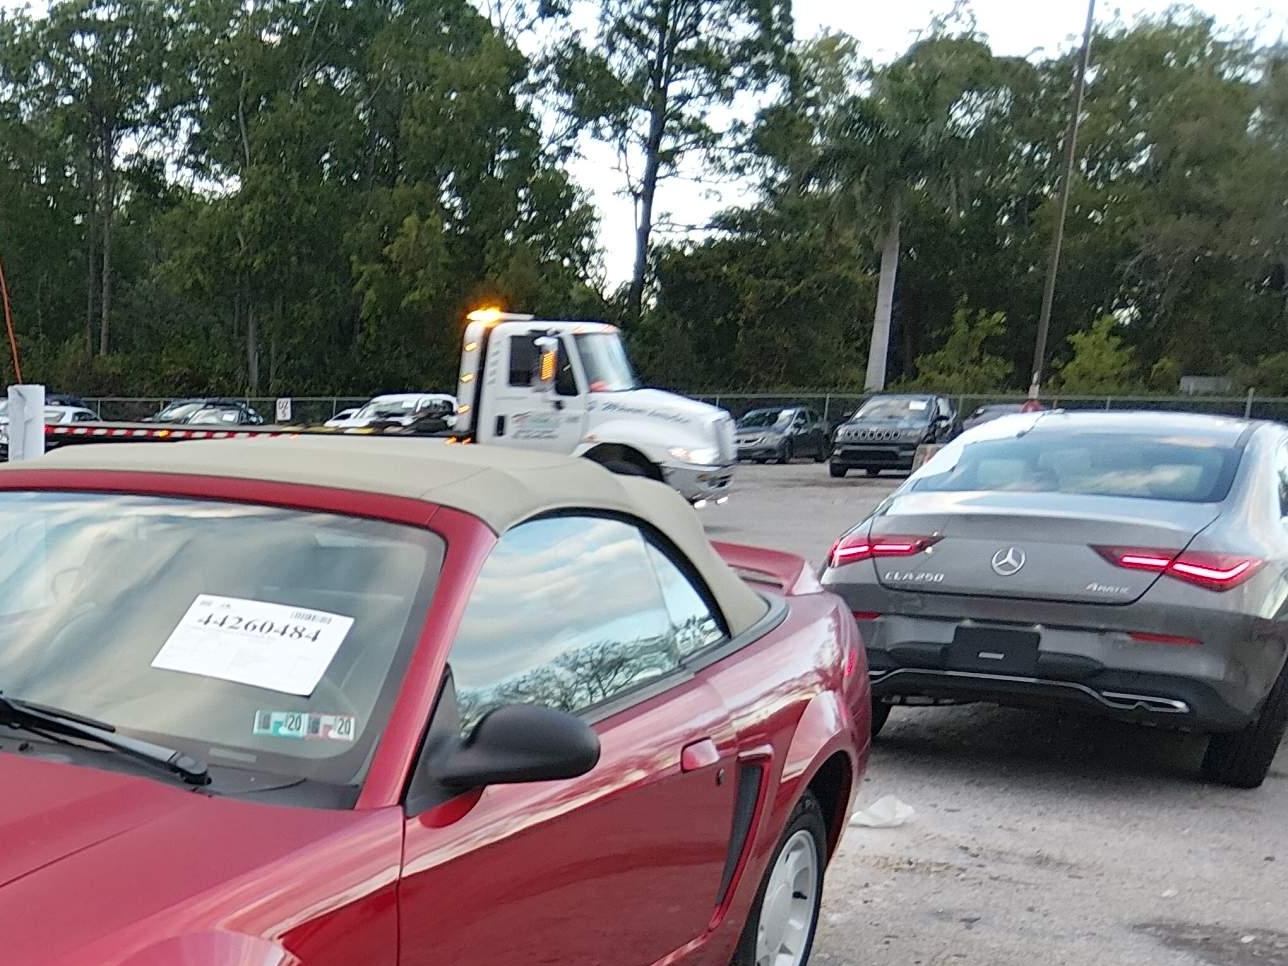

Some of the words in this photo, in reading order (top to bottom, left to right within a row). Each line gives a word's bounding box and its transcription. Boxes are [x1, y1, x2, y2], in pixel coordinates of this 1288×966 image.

[197, 612, 322, 643] 44260484
[287, 714, 302, 732] 20
[337, 718, 351, 736] 20
